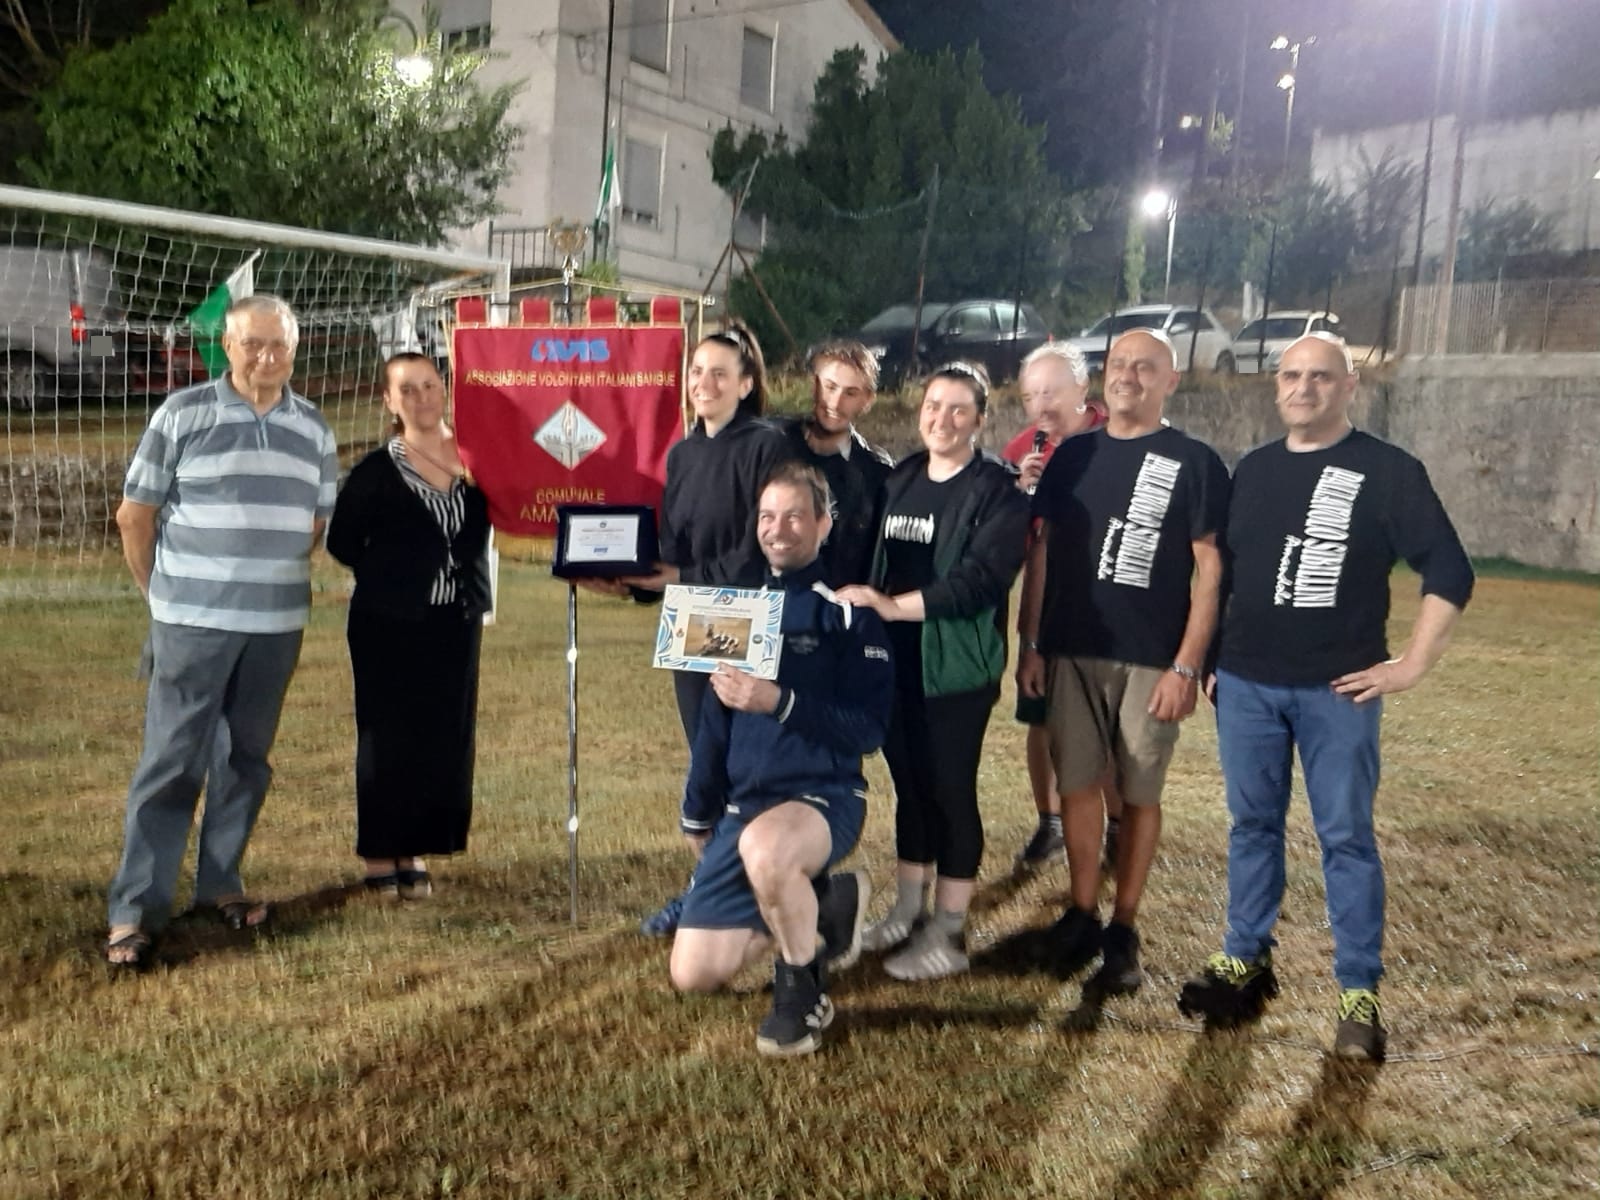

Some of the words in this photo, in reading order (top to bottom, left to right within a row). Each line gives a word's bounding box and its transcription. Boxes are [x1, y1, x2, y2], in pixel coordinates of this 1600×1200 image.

[464, 368, 537, 388] ASSOCIAZIONE
[539, 370, 594, 388] VOLONTARI
[536, 487, 606, 505] COMUNALE
[1292, 537, 1348, 608] SIBILLINI
